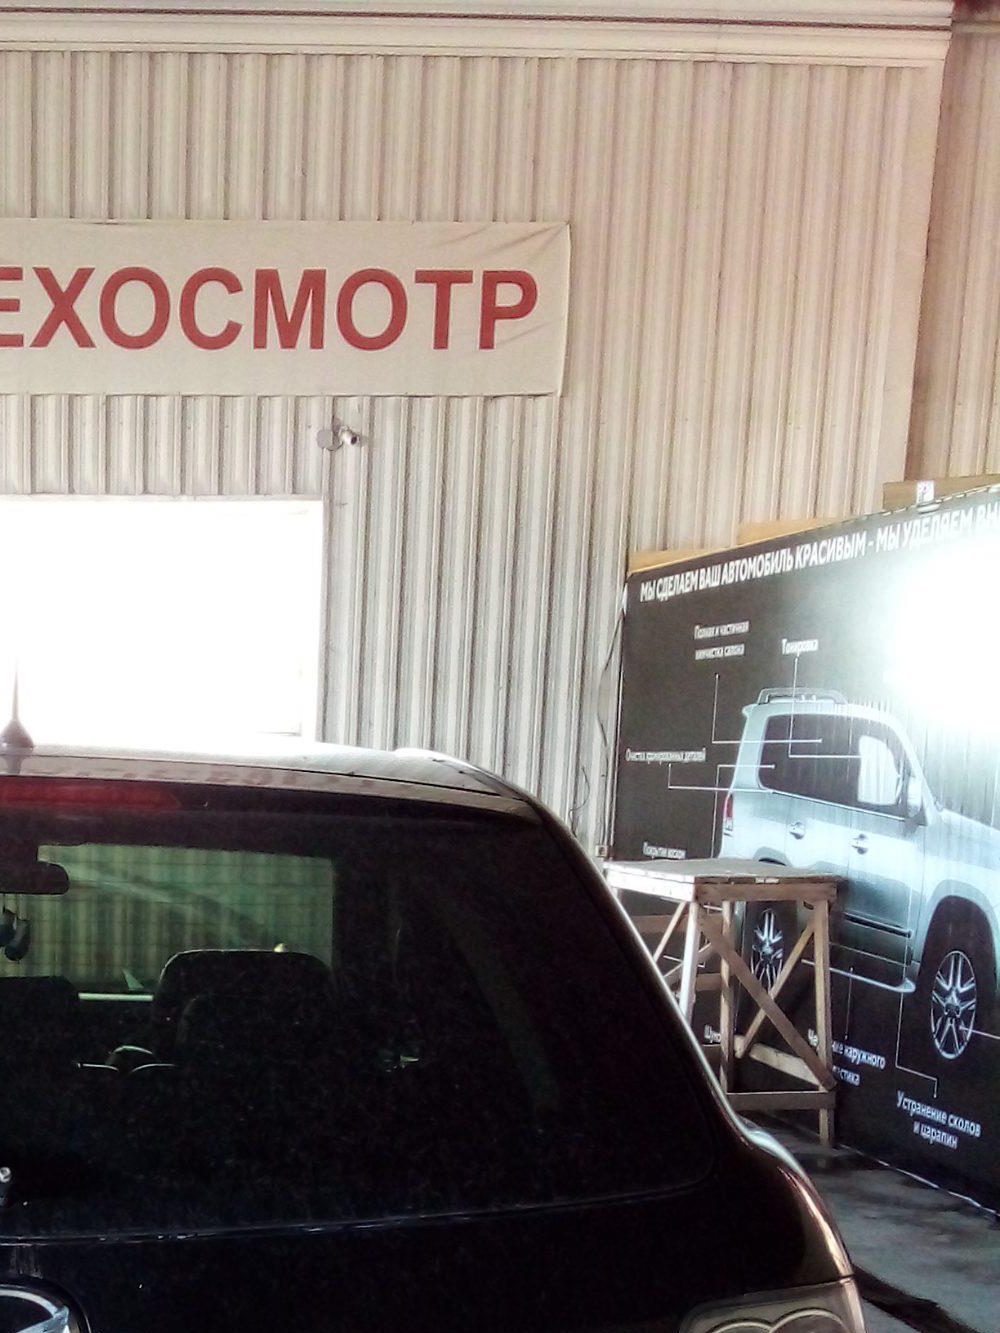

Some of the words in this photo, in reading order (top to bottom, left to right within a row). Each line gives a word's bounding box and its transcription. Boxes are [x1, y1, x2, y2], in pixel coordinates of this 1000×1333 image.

[640, 581, 656, 602] МЫ
[656, 569, 699, 601] СДЕЛАЕМ
[700, 566, 721, 590] ВАШ
[721, 547, 794, 584] АВТОМОБИЛЬ
[795, 530, 867, 570] КРАСИВЫМ
[876, 523, 901, 553] МЫ
[897, 1090, 947, 1125] Устранение
[948, 1114, 981, 1137] сколов
[920, 1124, 958, 1149] царапин
